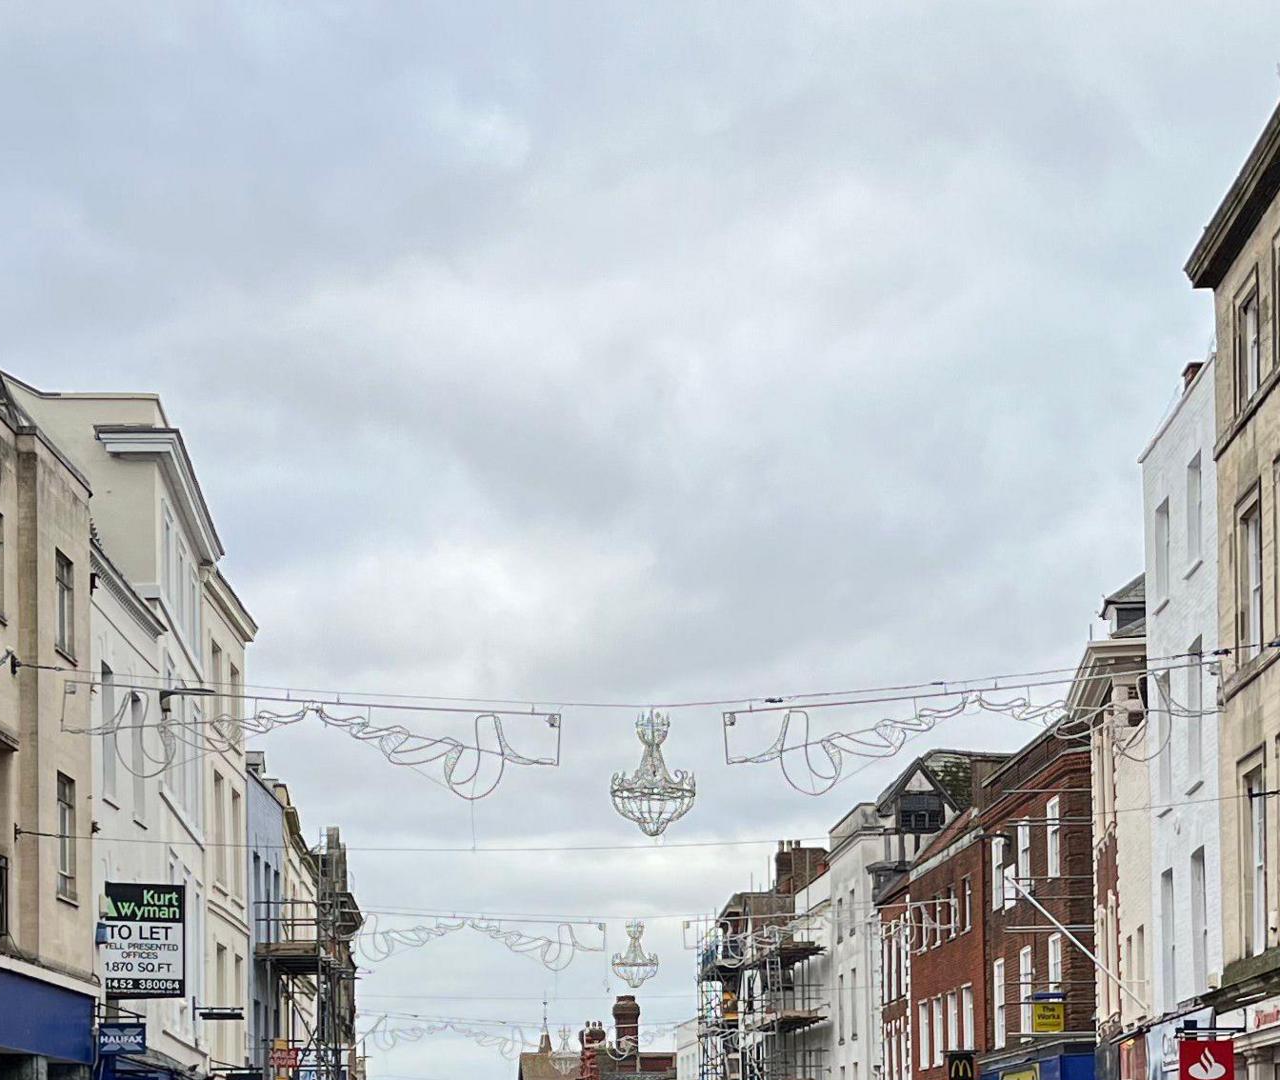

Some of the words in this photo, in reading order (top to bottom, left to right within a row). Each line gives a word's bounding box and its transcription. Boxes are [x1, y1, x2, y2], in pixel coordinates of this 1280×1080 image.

[143, 890, 179, 905] Kurt
[117, 902, 180, 920] Wyman
[107, 925, 132, 940] TO
[139, 926, 173, 940] LET
[128, 943, 179, 951] PRESENTED
[121, 951, 158, 959] OFFICES
[139, 981, 179, 989] 380064
[100, 1035, 143, 1043] HALIFAX
